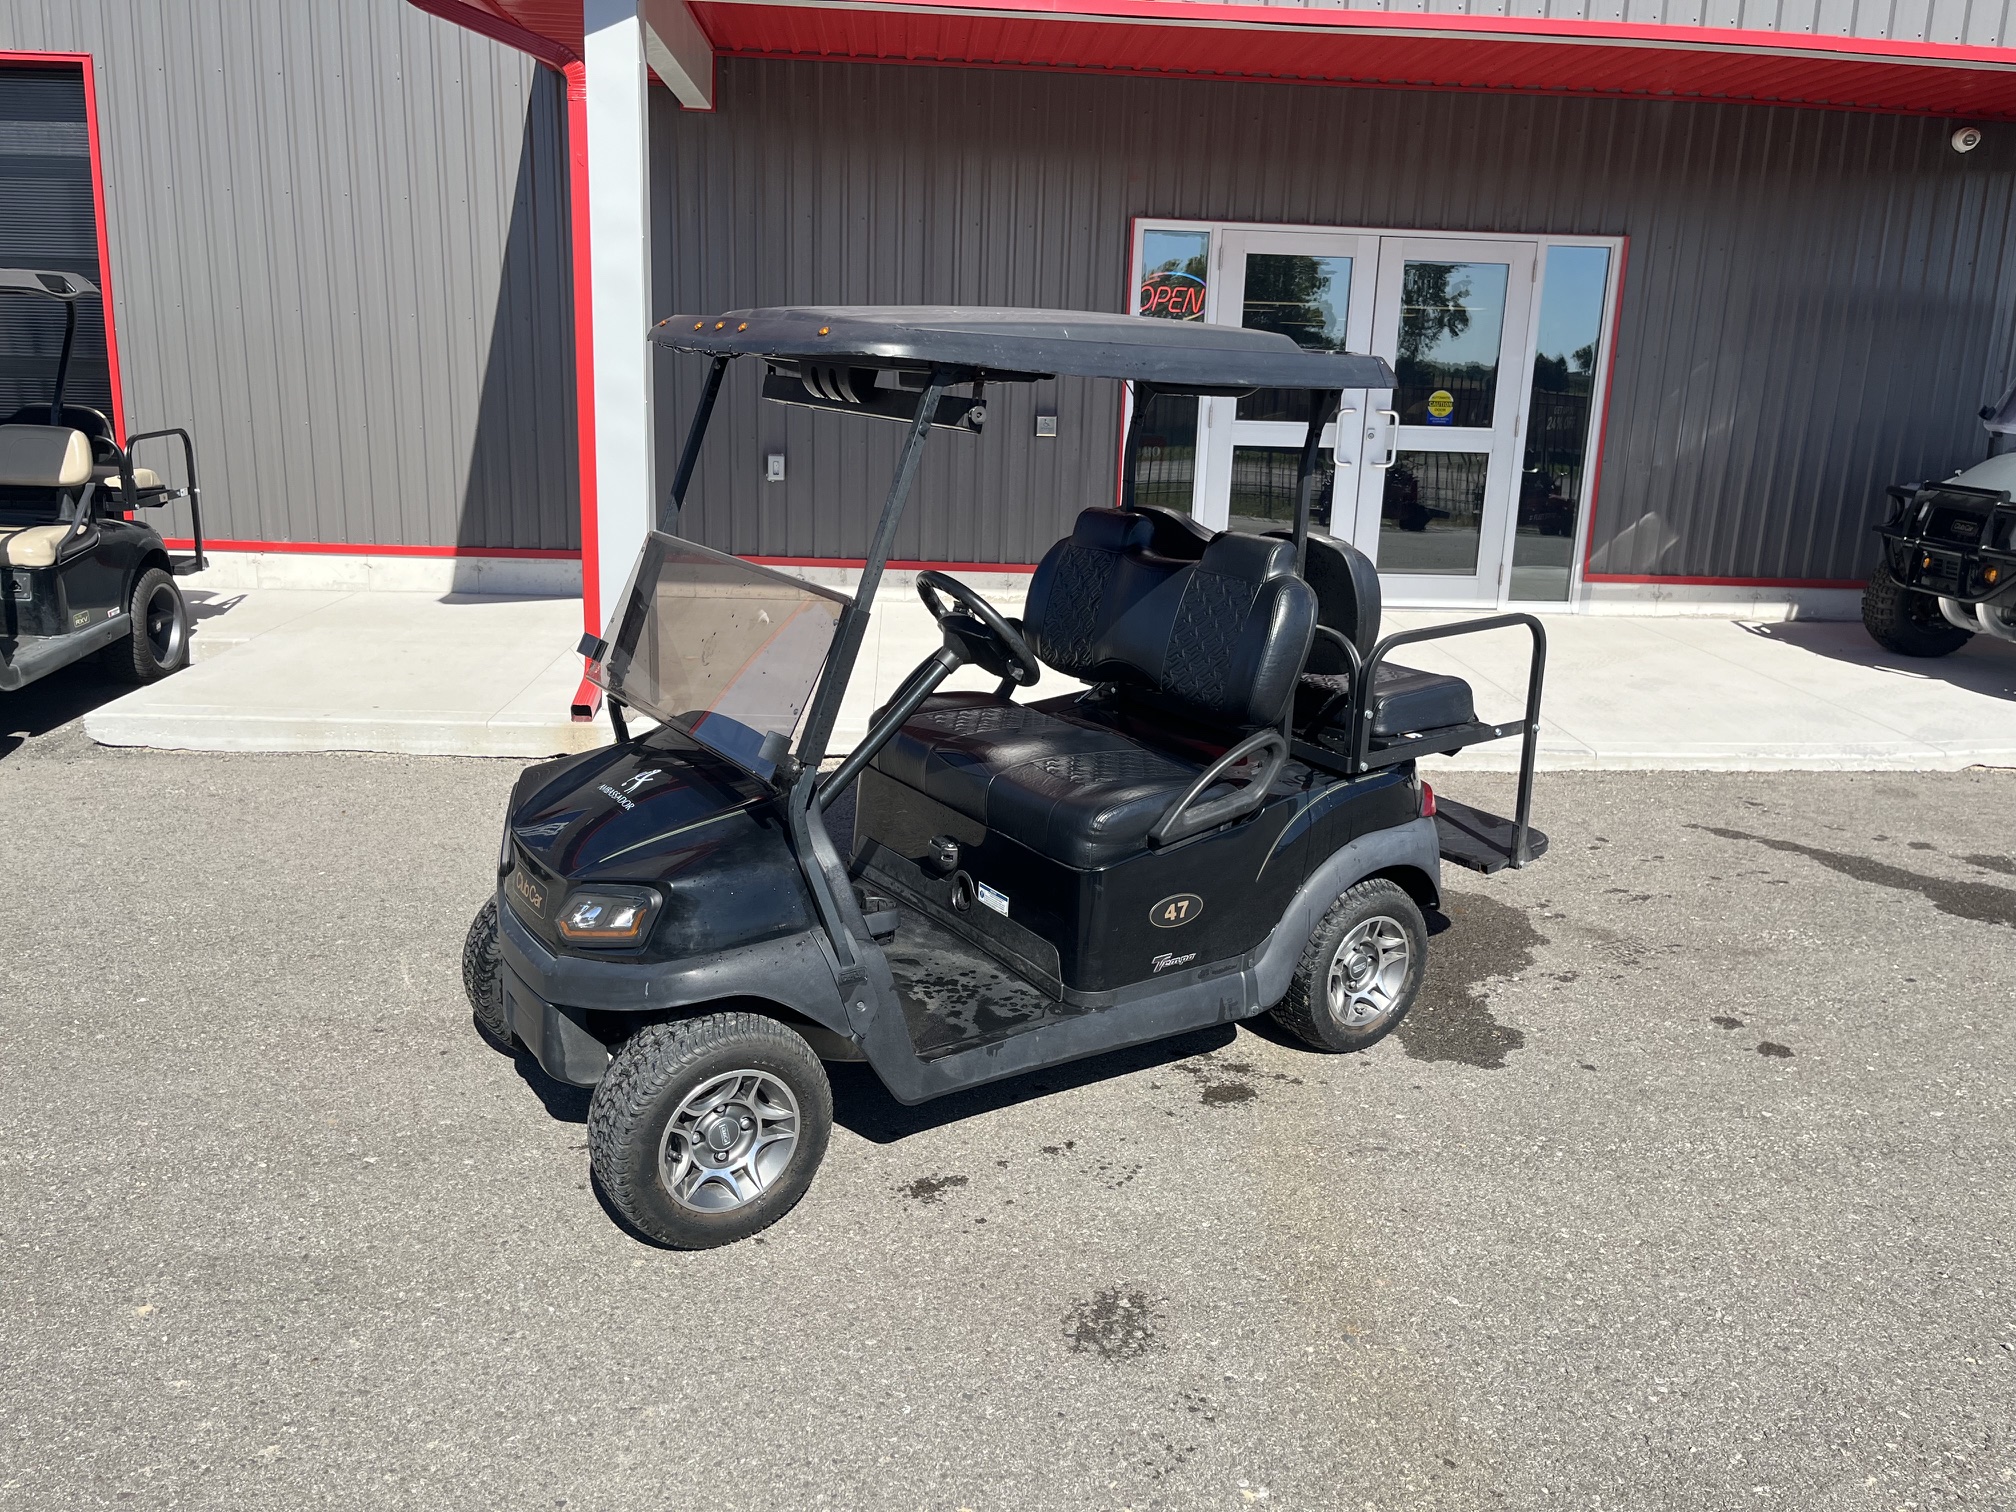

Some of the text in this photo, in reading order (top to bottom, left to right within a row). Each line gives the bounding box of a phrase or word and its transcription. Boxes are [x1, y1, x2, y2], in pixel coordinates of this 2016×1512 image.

[1141, 285, 1205, 313] OPEN
[75, 616, 88, 626] RXV
[597, 784, 635, 811] AMBASSADOR
[1164, 900, 1189, 920] 47
[1151, 952, 1197, 974] Tempo
